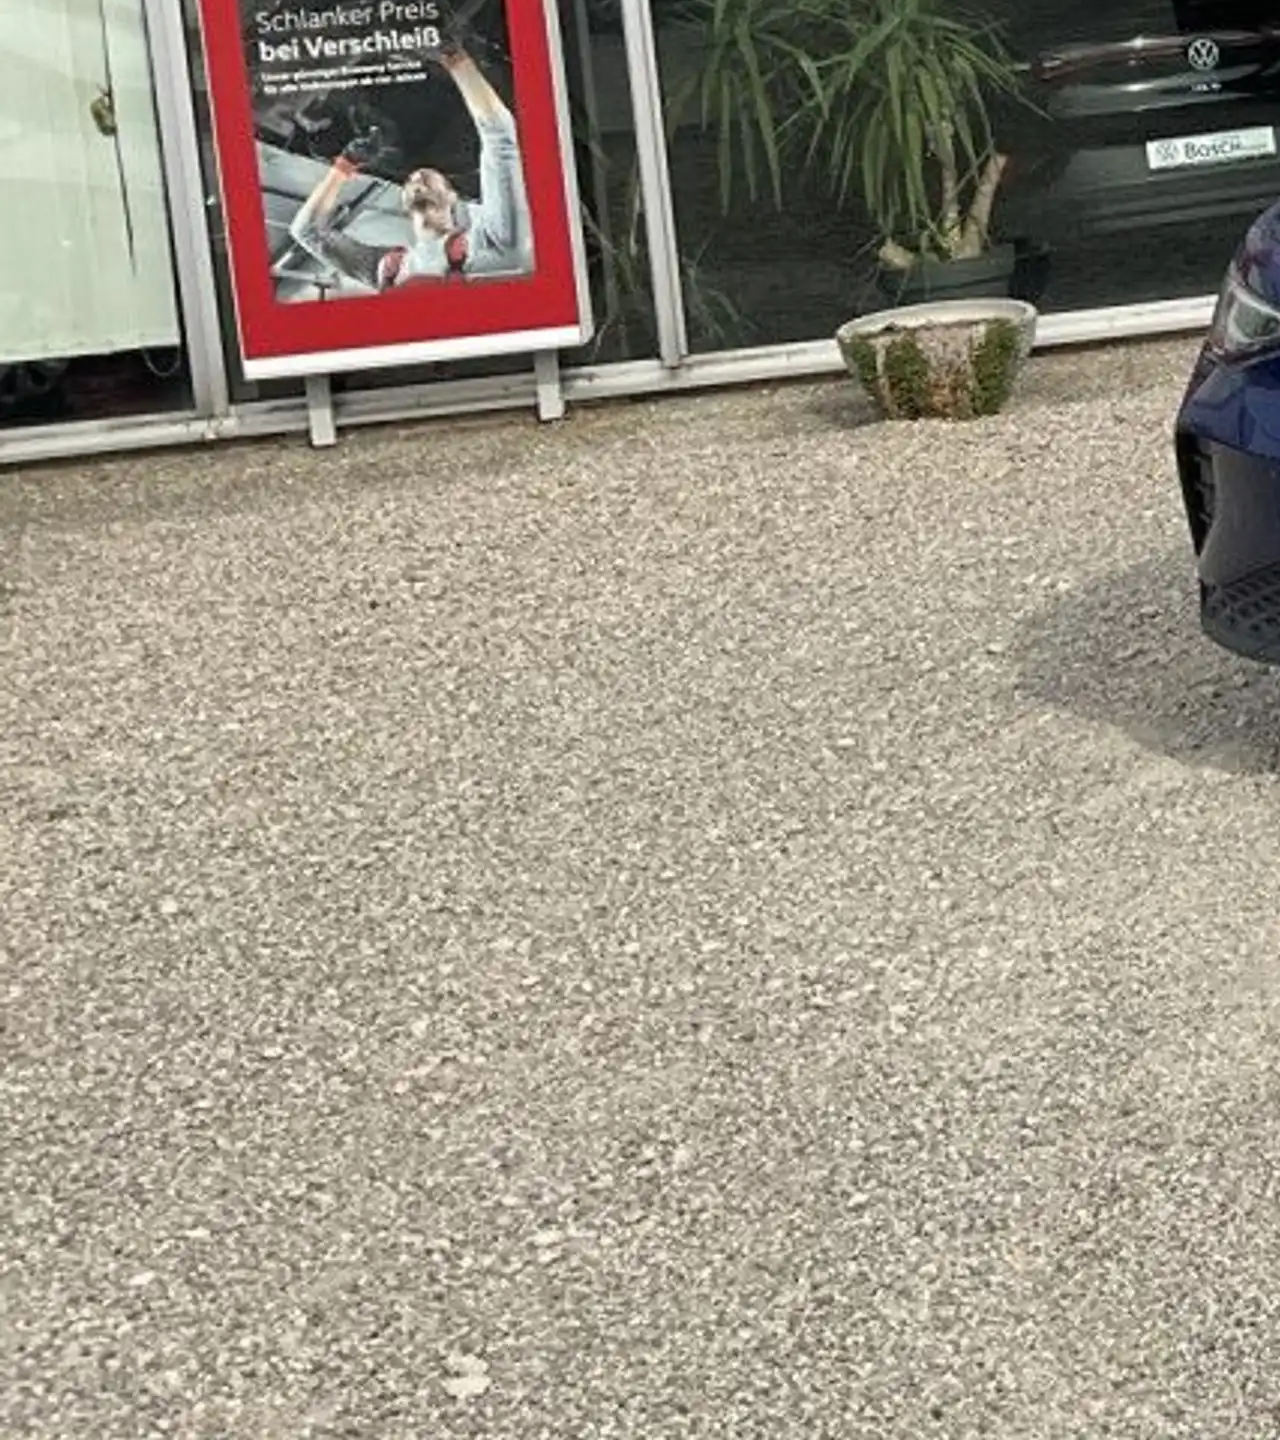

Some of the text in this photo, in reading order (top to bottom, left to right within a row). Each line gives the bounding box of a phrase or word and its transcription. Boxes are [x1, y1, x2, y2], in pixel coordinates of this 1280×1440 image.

[255, 0, 439, 34] Schlanker Preis
[258, 26, 442, 62] bei Verschleiß
